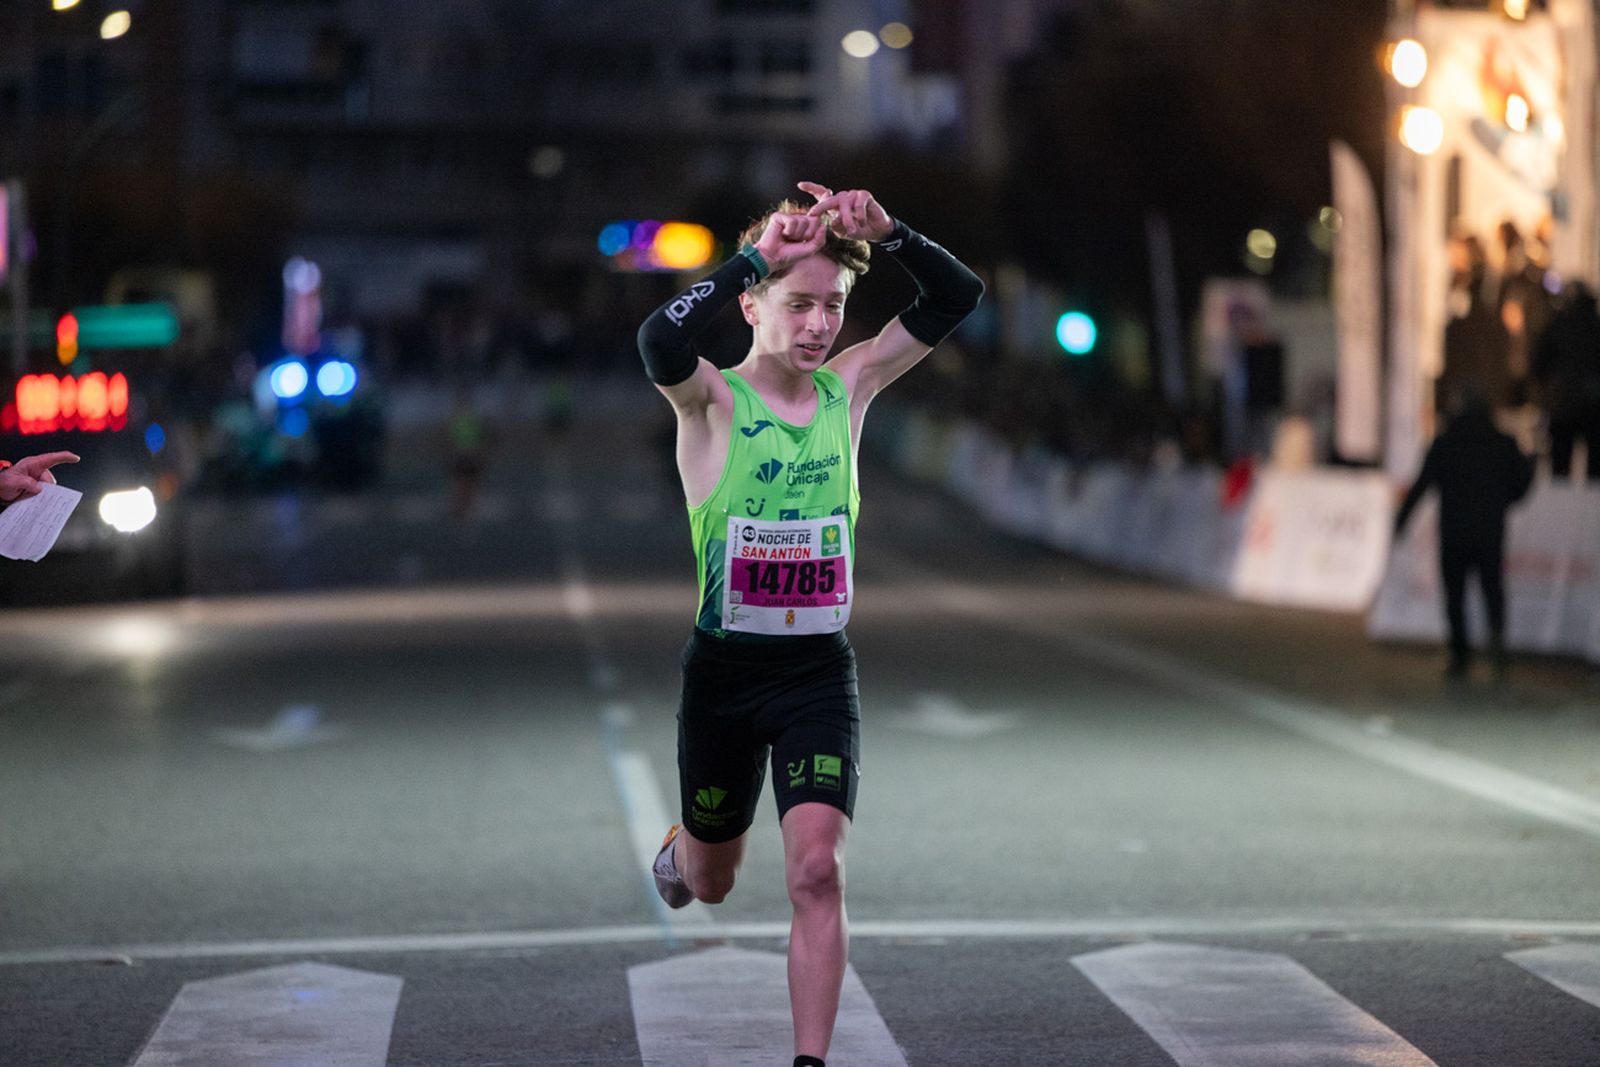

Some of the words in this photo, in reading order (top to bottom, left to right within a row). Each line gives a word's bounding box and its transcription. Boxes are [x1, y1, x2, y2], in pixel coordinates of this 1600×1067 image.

[787, 455, 840, 473] Fundación
[786, 471, 830, 486] Unicaja
[757, 533, 796, 545] NOCHE
[797, 533, 811, 544] DE
[741, 545, 767, 559] SAN
[769, 544, 811, 560] ANTÓN
[744, 560, 836, 595] 14785
[786, 597, 818, 607] CARLOS
